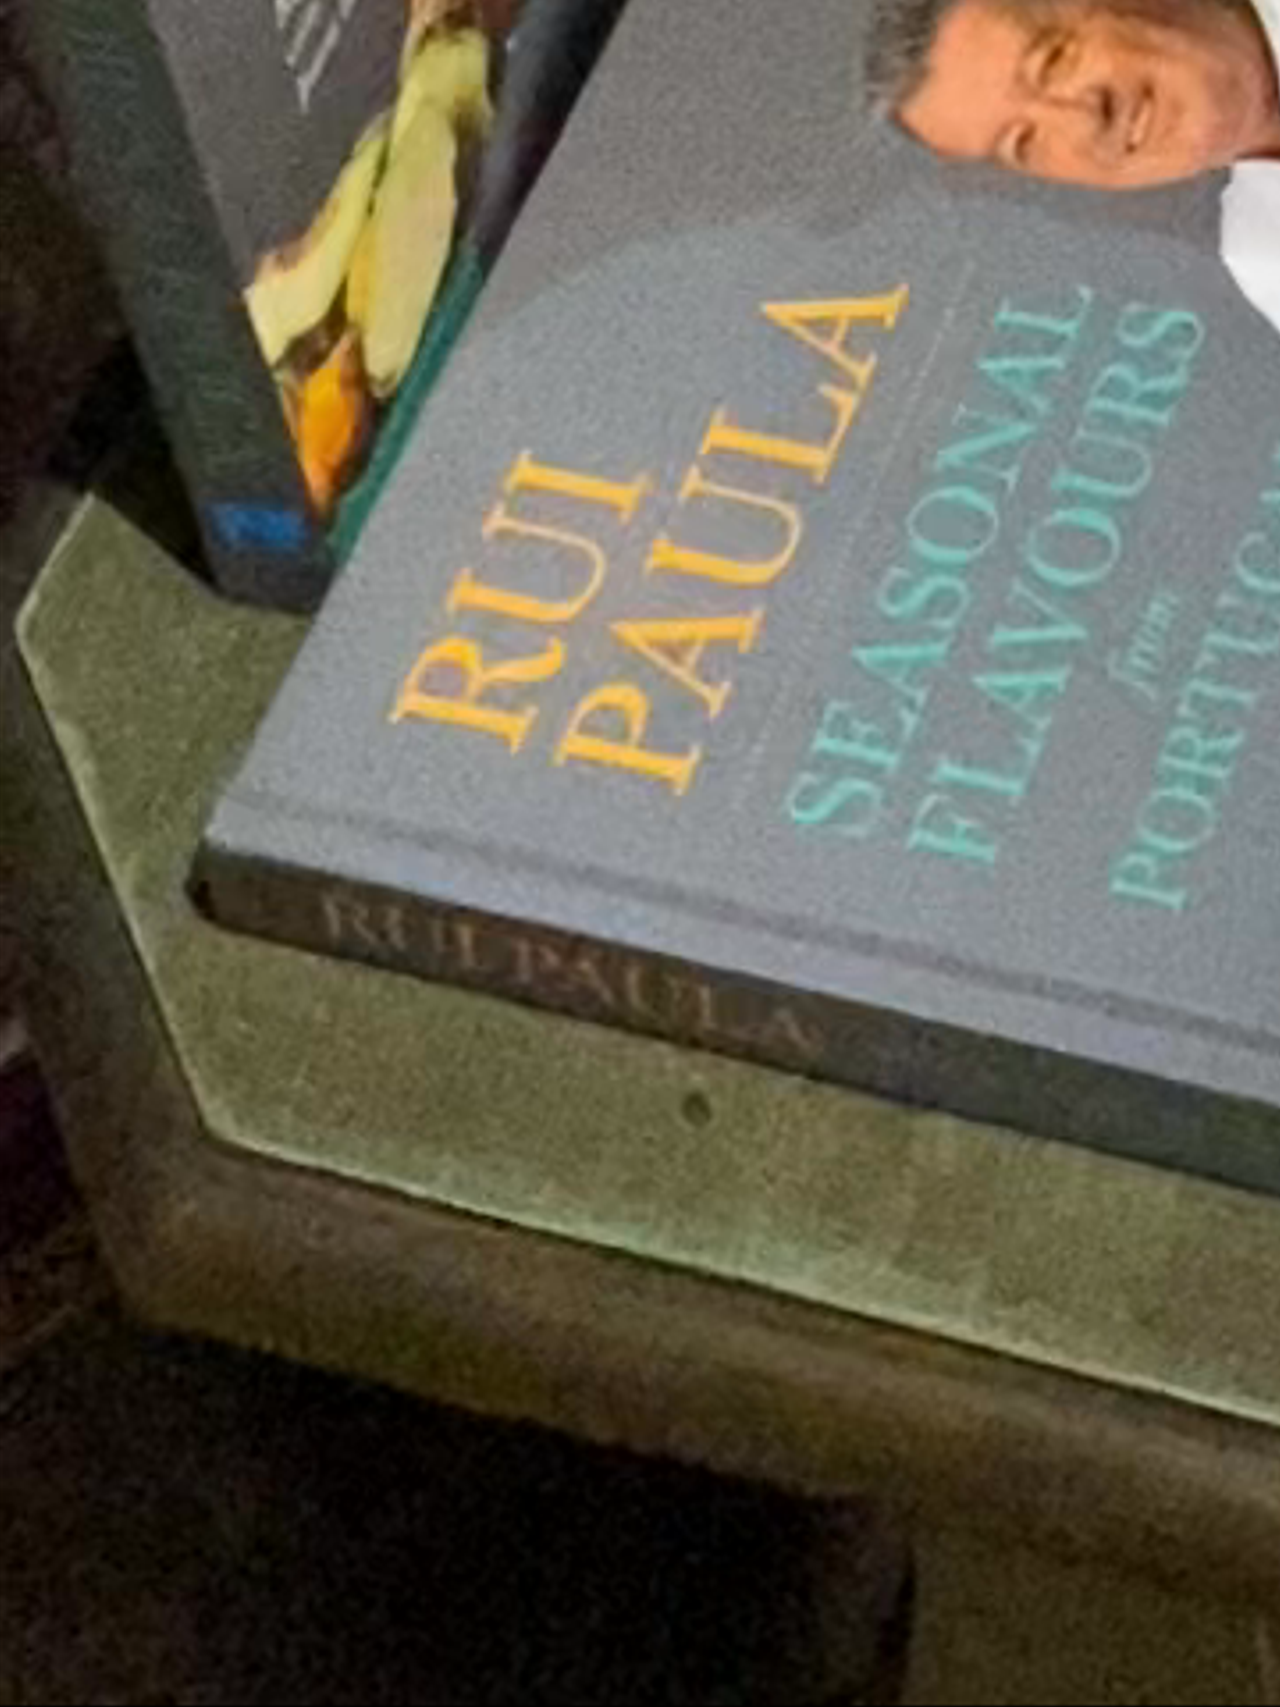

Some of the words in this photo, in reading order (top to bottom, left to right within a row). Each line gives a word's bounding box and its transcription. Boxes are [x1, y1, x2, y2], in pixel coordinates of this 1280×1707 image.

[388, 449, 653, 755] RUI
[553, 282, 911, 796] PAULA
[783, 284, 1095, 841] SEASONAL
[908, 302, 1204, 868] FLAVOURS
